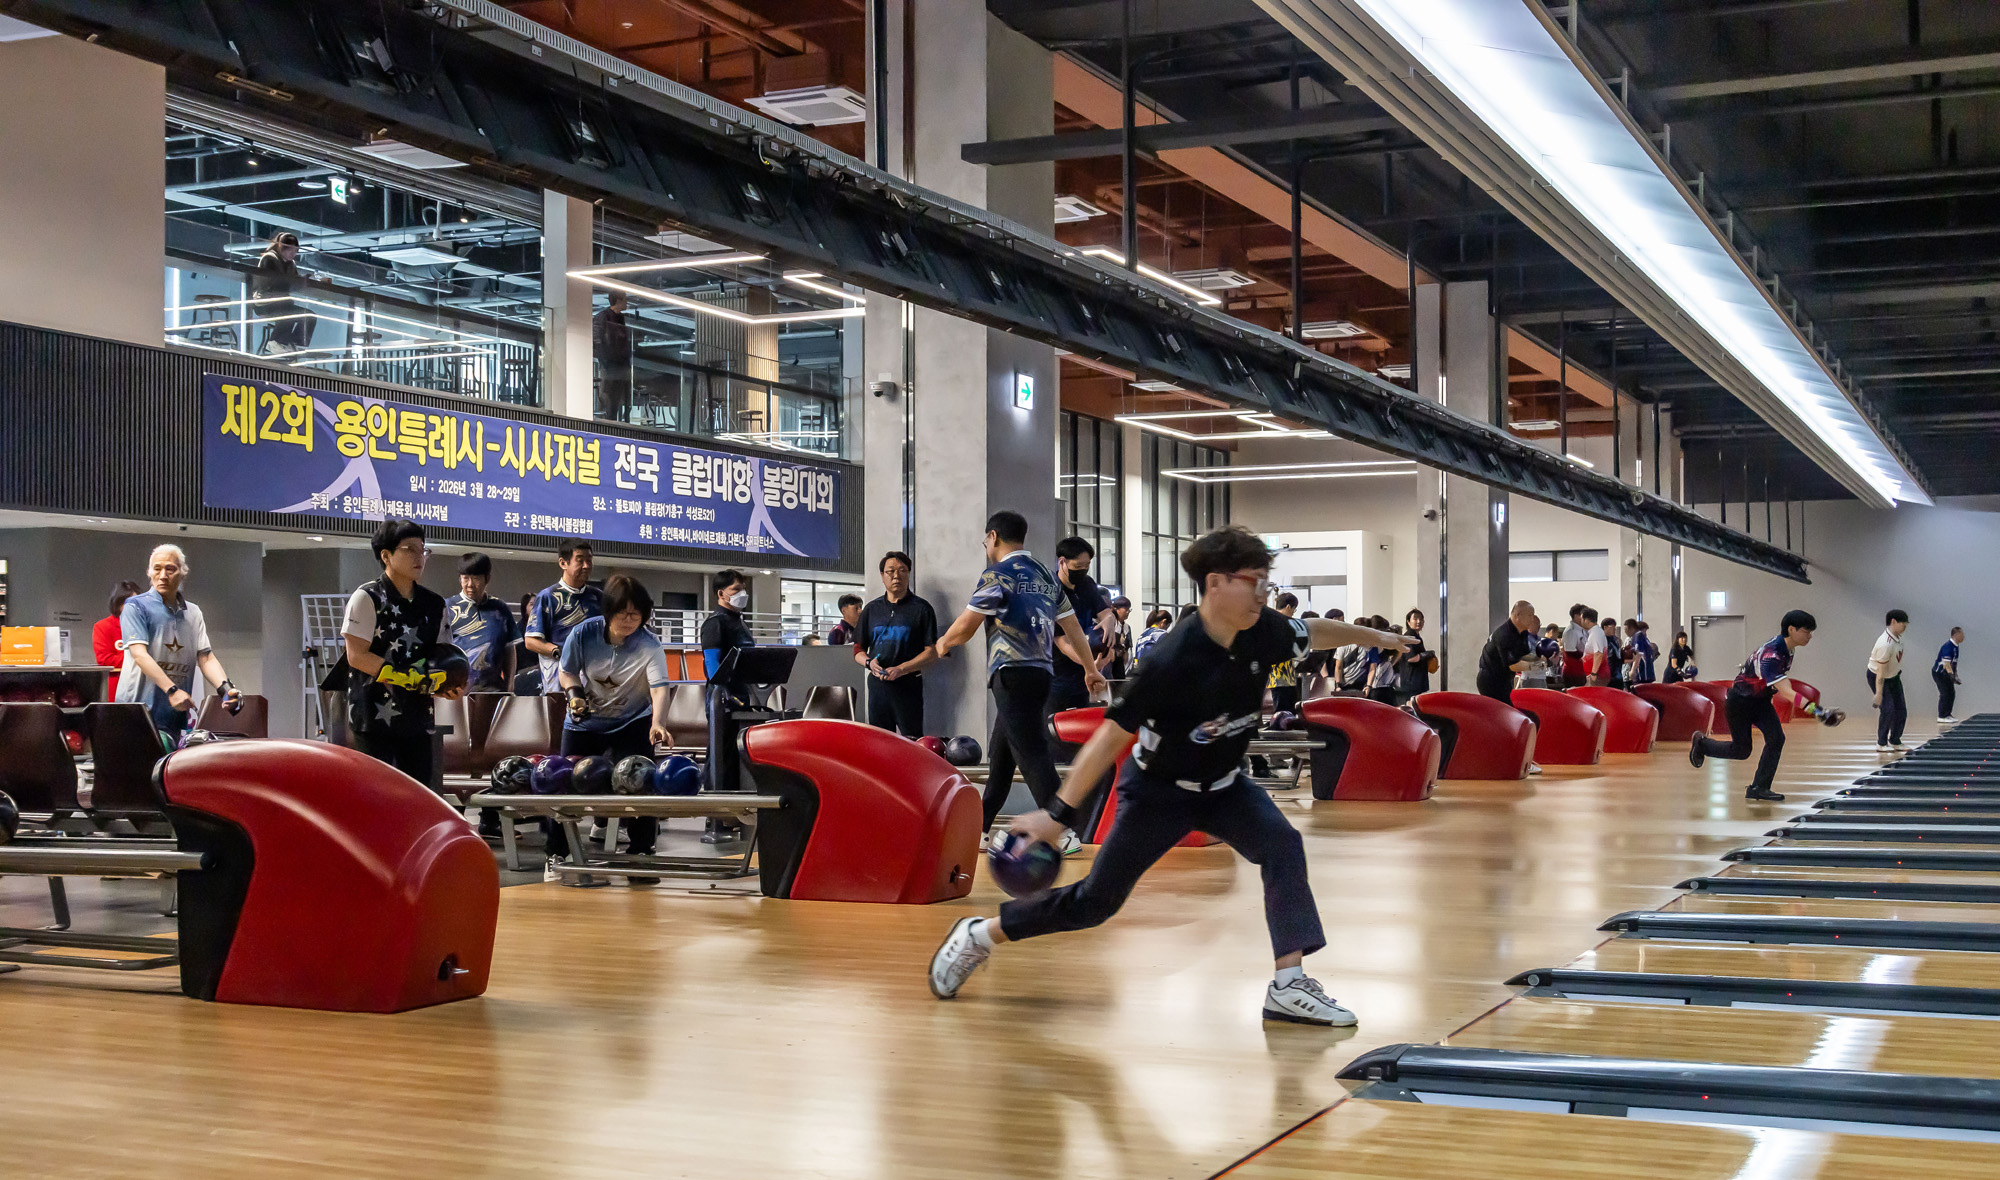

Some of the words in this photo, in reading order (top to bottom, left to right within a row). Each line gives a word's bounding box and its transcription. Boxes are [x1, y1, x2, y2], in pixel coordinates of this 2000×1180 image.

[220, 383, 314, 453] 제2회
[333, 400, 601, 487] 용인특례시-시사저널
[614, 442, 660, 495] 전국
[671, 450, 754, 504] 클럽대항
[762, 464, 834, 515] 볼링대회
[409, 475, 427, 493] 일시
[438, 479, 467, 497] 2026년
[470, 482, 483, 499] 3월
[486, 485, 521, 503] 28~29일
[310, 492, 330, 511] 주최
[592, 496, 607, 511] 장소
[504, 511, 520, 528] 주관
[530, 514, 594, 535] 용인특례시볼링협회
[638, 524, 653, 539] 후원
